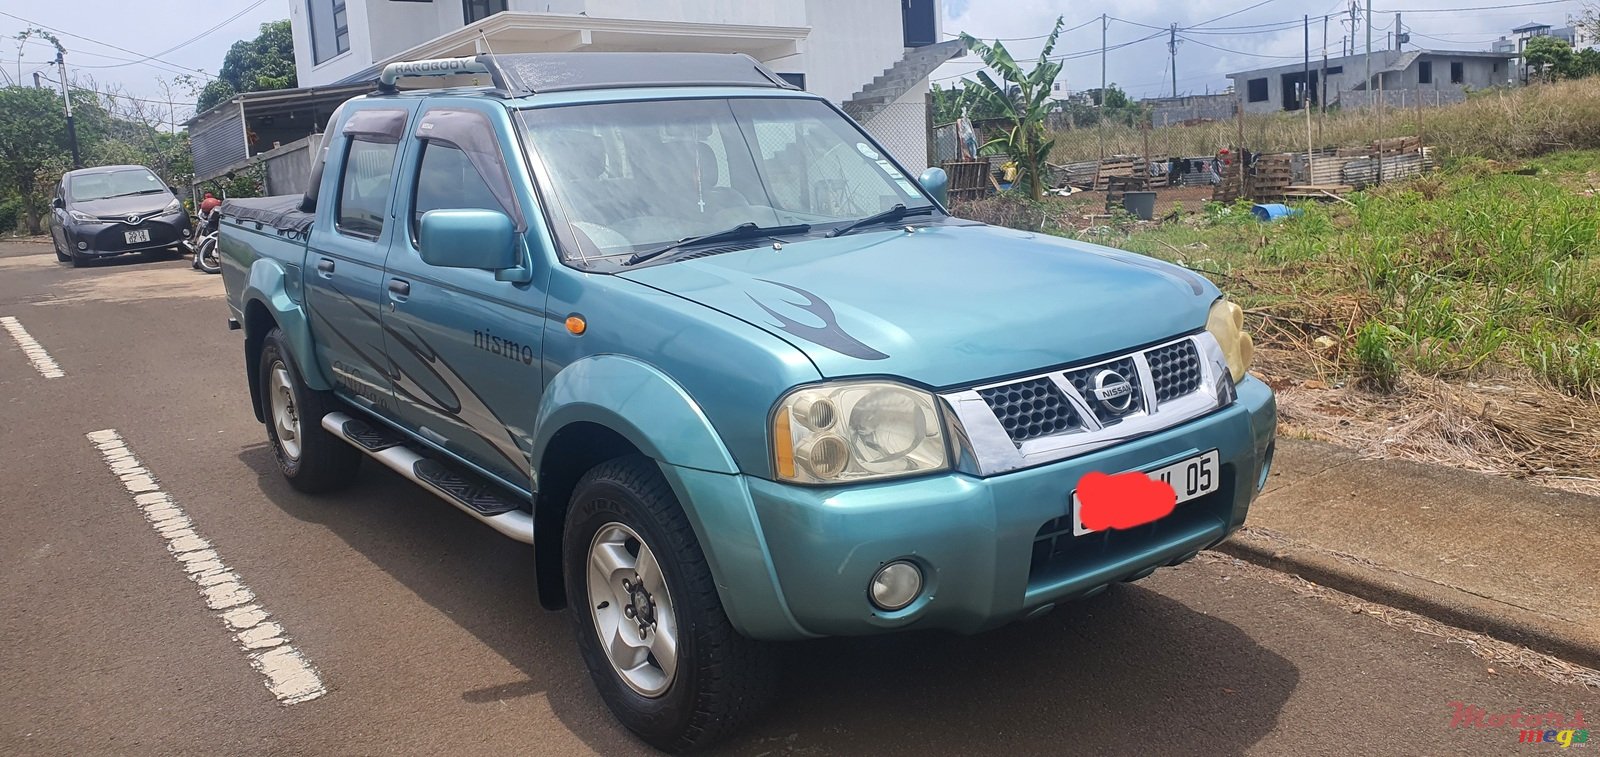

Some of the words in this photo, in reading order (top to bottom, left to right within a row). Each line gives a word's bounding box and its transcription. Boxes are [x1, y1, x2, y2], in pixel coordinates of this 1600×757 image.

[473, 327, 533, 366] nismo
[1102, 384, 1131, 398] NISSAN
[1186, 457, 1212, 496] 05
